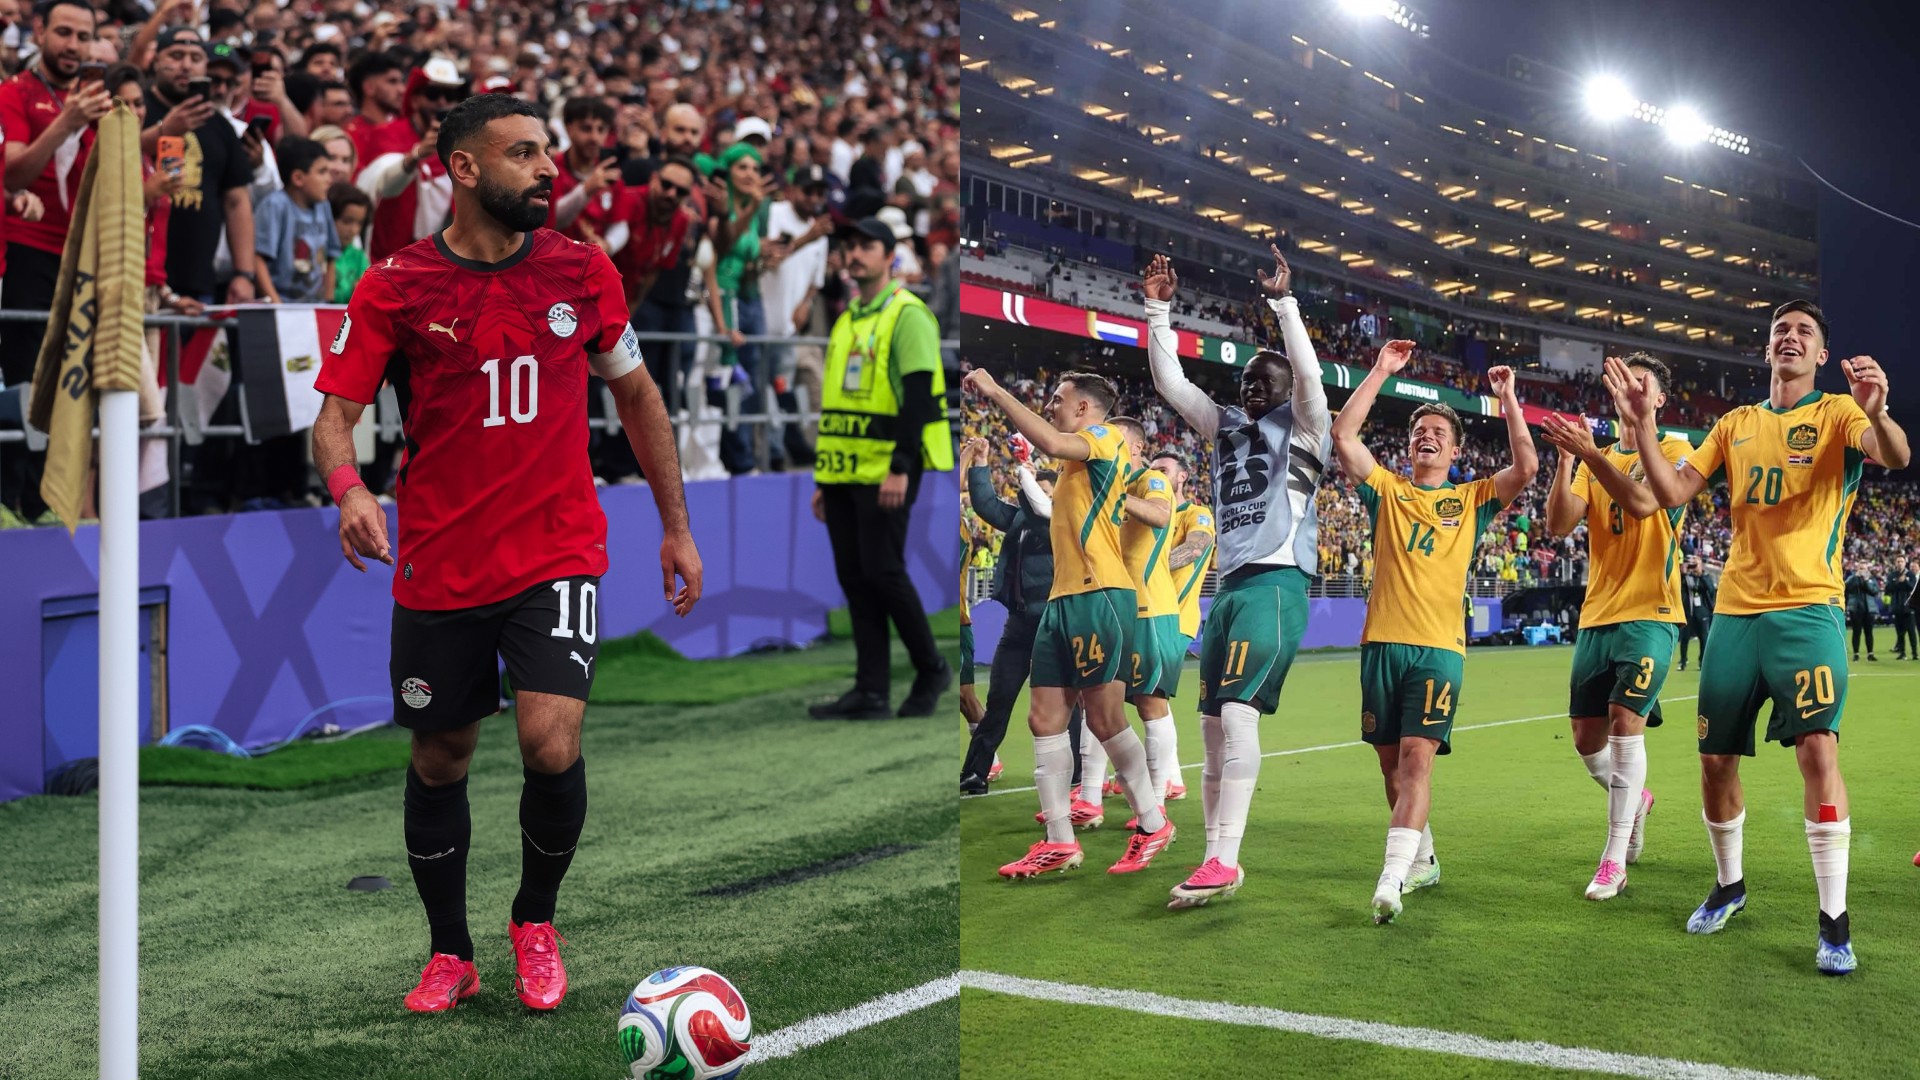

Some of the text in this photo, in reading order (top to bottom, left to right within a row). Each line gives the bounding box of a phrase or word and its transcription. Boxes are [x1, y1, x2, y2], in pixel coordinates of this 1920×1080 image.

[480, 355, 538, 427] 10
[1395, 381, 1439, 401] AUSTRALIA
[1230, 482, 1252, 497] FIFA
[1746, 466, 1783, 505] 20
[1221, 501, 1267, 519] WORLD CUP
[1221, 511, 1267, 535] 2026
[1407, 522, 1436, 557] 14
[551, 581, 596, 645] 10
[1072, 633, 1105, 669] 24
[1226, 640, 1250, 676] 11
[1635, 656, 1655, 690] 3
[1795, 665, 1835, 709] 20
[1424, 678, 1452, 717] 14
